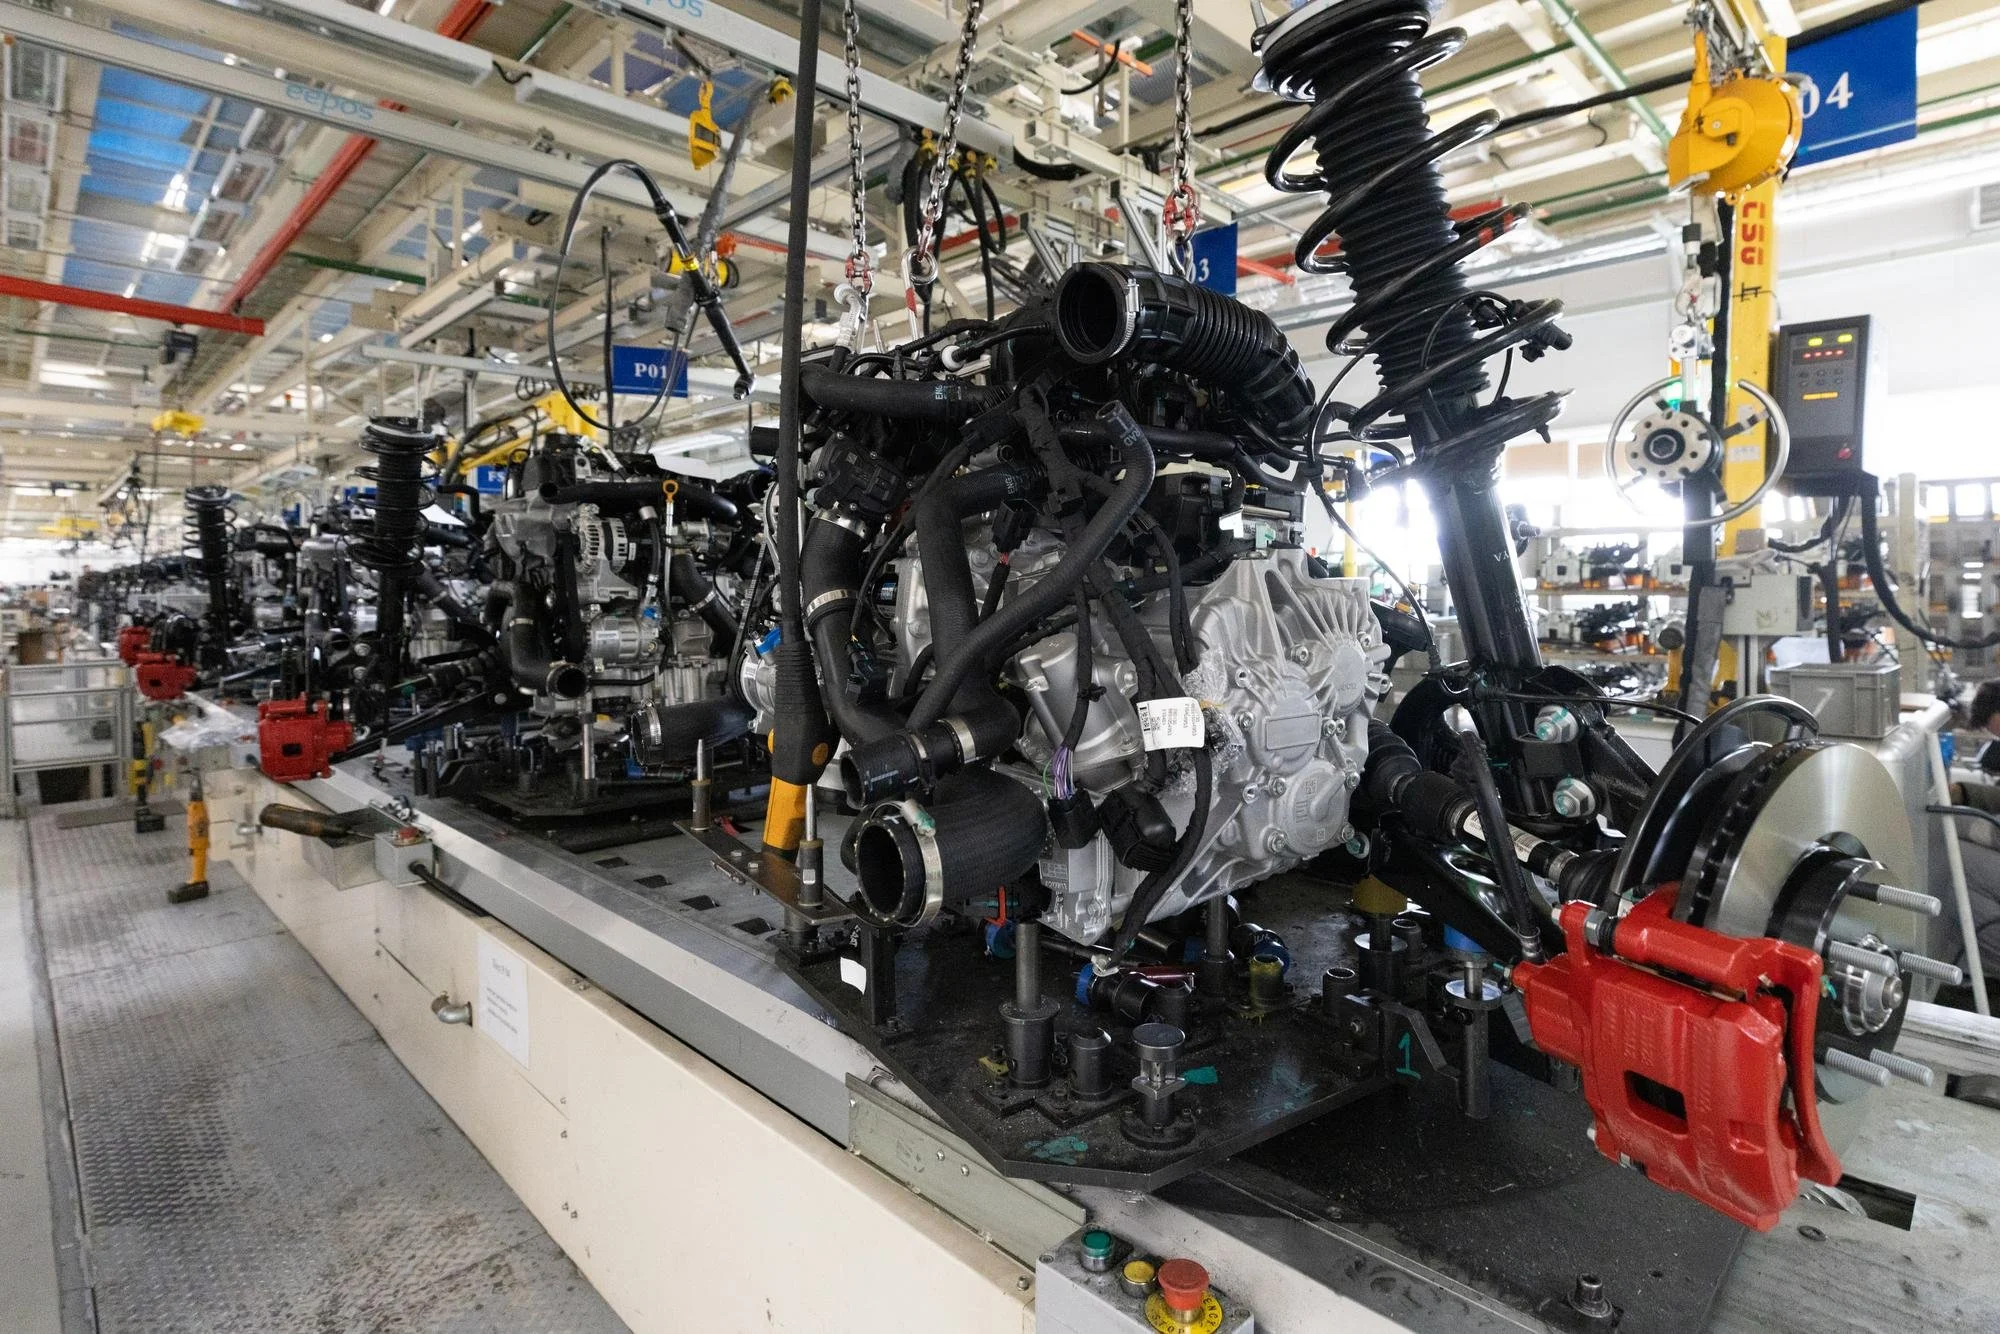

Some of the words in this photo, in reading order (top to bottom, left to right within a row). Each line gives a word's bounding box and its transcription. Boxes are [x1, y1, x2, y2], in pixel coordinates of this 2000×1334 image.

[286, 83, 373, 120] eepos
[1800, 71, 1854, 120] 04
[634, 362, 667, 379] P01
